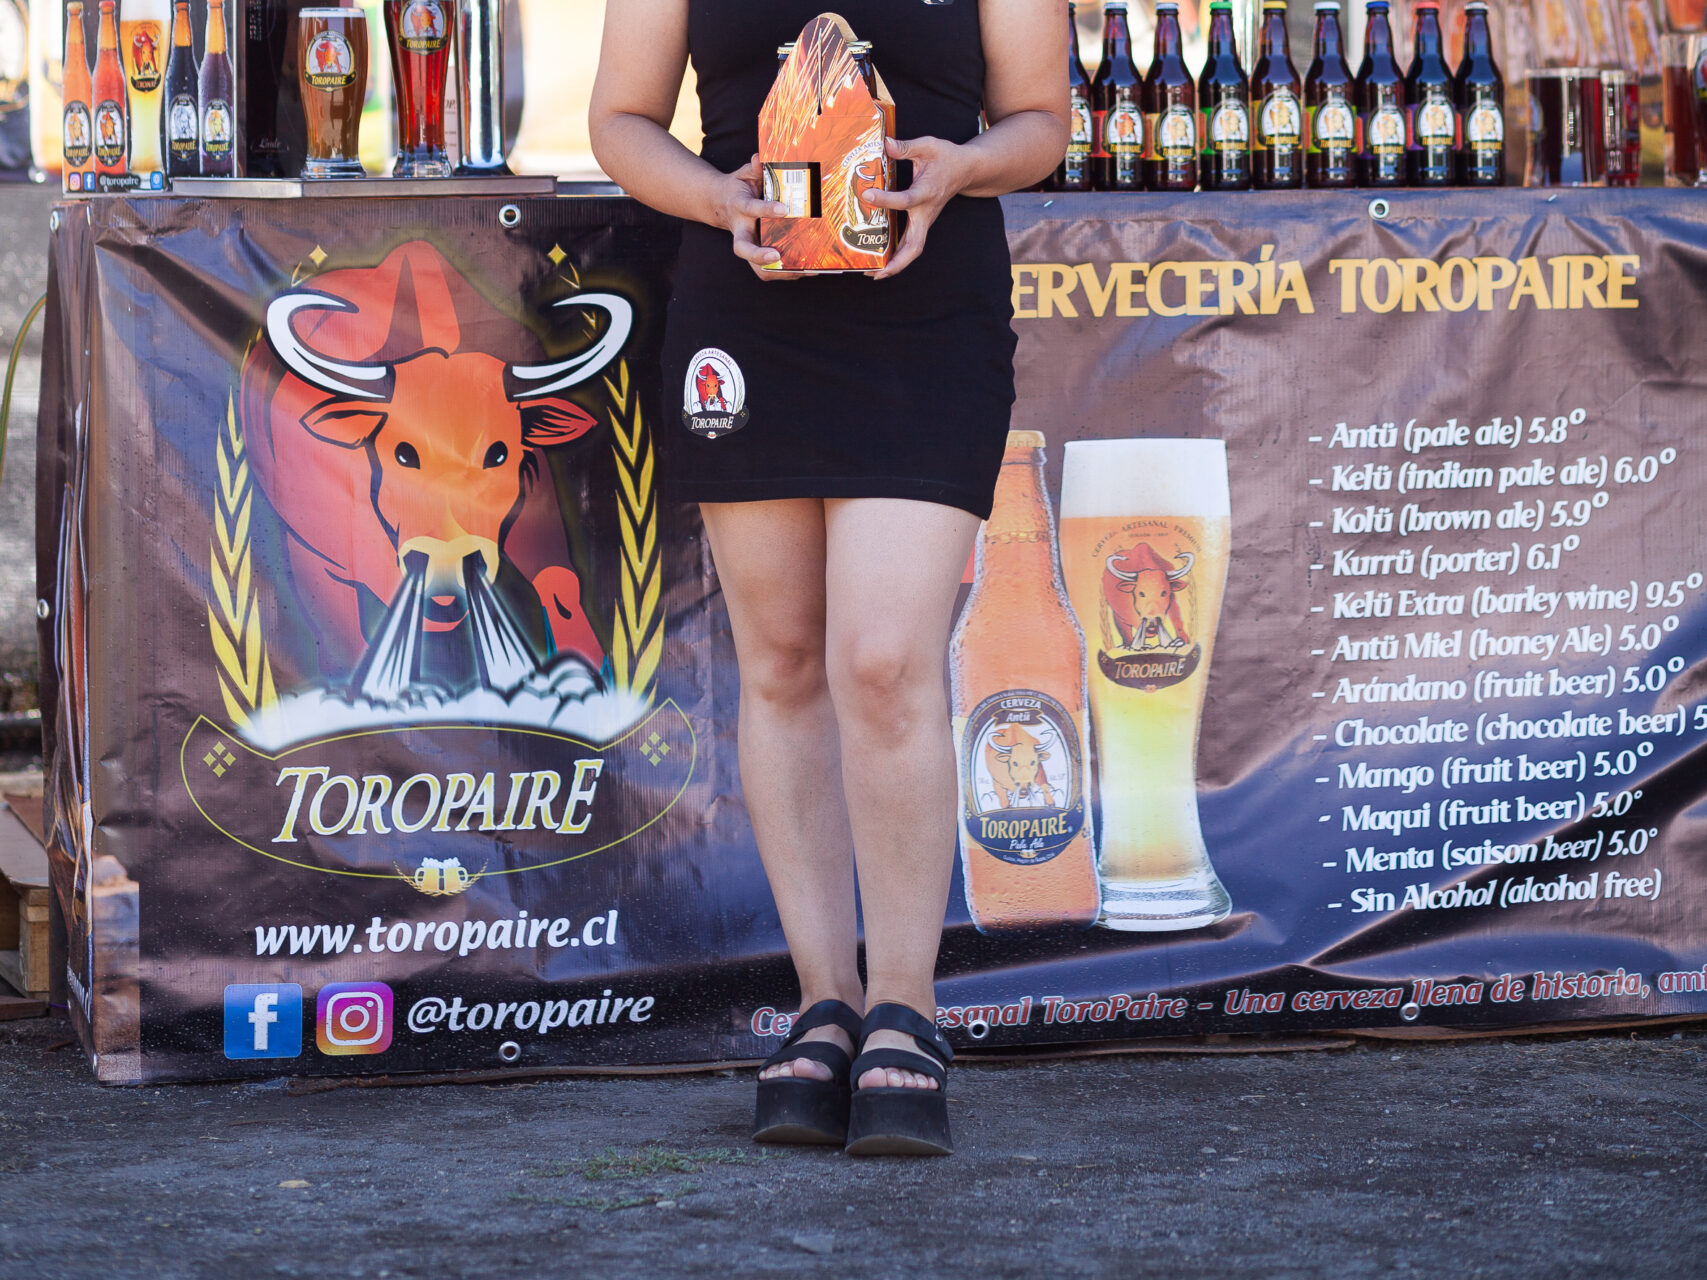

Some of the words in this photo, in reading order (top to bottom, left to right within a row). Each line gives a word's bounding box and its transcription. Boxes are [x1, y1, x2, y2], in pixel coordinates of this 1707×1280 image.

[1011, 244, 1315, 319] ERVECERÍA
[1329, 254, 1639, 314] TOROPAIRE
[691, 416, 734, 430] TOROPAIRE
[1329, 422, 1399, 449] Antü
[1403, 418, 1470, 453] (pale
[1474, 416, 1522, 448] ale)
[1331, 463, 1392, 491] Kelü
[1398, 460, 1493, 494] (indian
[1497, 458, 1555, 493] pale
[1559, 456, 1608, 488] ale)
[1332, 505, 1394, 534] Kolü
[1398, 503, 1491, 536] (brown
[1496, 499, 1545, 531] ale)
[1332, 549, 1415, 577] Kurrü
[1420, 542, 1520, 580] (porter)
[1333, 590, 1393, 619] Kelü
[1397, 588, 1464, 618] Extra
[1471, 584, 1563, 619] (barley
[1565, 580, 1638, 613] wine)
[1331, 635, 1399, 662] Antü
[1403, 629, 1462, 658] Miel
[1469, 627, 1562, 662] (honey
[1561, 624, 1612, 656] Ale)
[1115, 658, 1186, 679] TOROPAIRE
[1331, 674, 1467, 704] Arándano
[1473, 670, 1544, 703] (fruit
[1548, 666, 1616, 698] beer)
[1000, 698, 1042, 709] CERVEZA
[1005, 711, 1031, 723] Antü
[1334, 716, 1468, 747] Chocolate
[1475, 712, 1612, 745] (chocolate
[1617, 705, 1686, 738] beer)
[1337, 763, 1434, 794] Mango
[1441, 756, 1512, 789] (fruit
[1516, 751, 1586, 783] beer)
[272, 758, 605, 844] TOROPAIRE
[1342, 802, 1431, 836] Maqui
[1438, 798, 1511, 831] (fruit
[1515, 791, 1585, 824] beer)
[980, 812, 1068, 839] TOROPAIRE
[1345, 845, 1434, 873] Menta
[1441, 839, 1537, 871] (saison
[1541, 830, 1604, 862] beer)
[1350, 887, 1395, 914] Sin
[1399, 880, 1497, 911] Alcohol
[1499, 873, 1599, 909] (alcohol
[1603, 868, 1662, 900] free)
[254, 909, 618, 957] www.toropaire.cl
[407, 989, 656, 1035] @toropaire
[1042, 992, 1188, 1024] ToroPaire
[1224, 988, 1284, 1015] Una
[1291, 987, 1402, 1013] cerveza
[1410, 977, 1483, 1007] llena
[1490, 973, 1524, 1003] de
[1532, 967, 1650, 1000] historia,
